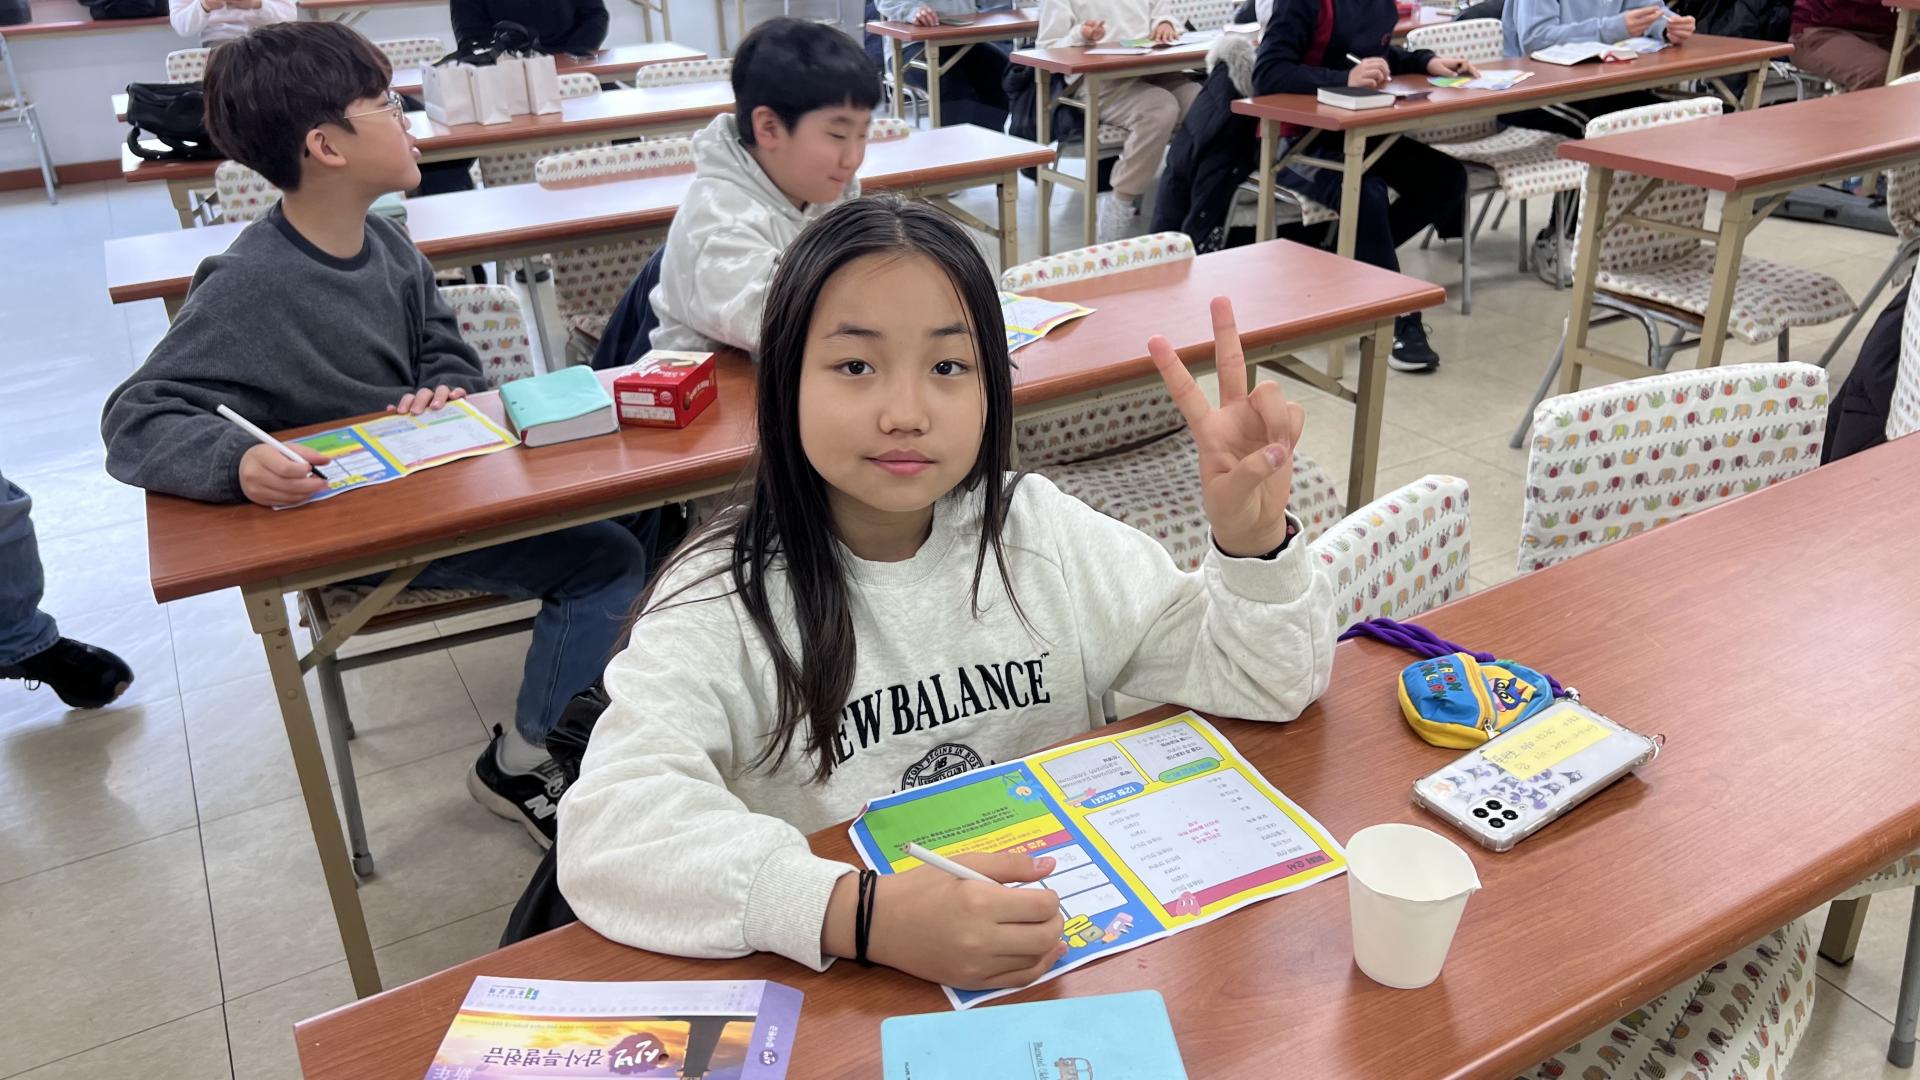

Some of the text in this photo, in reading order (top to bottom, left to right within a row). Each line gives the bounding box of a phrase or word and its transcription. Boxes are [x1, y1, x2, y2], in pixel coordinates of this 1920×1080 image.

[830, 689, 883, 769] EW
[483, 1040, 660, 1068] 신년 감사특별헌금
